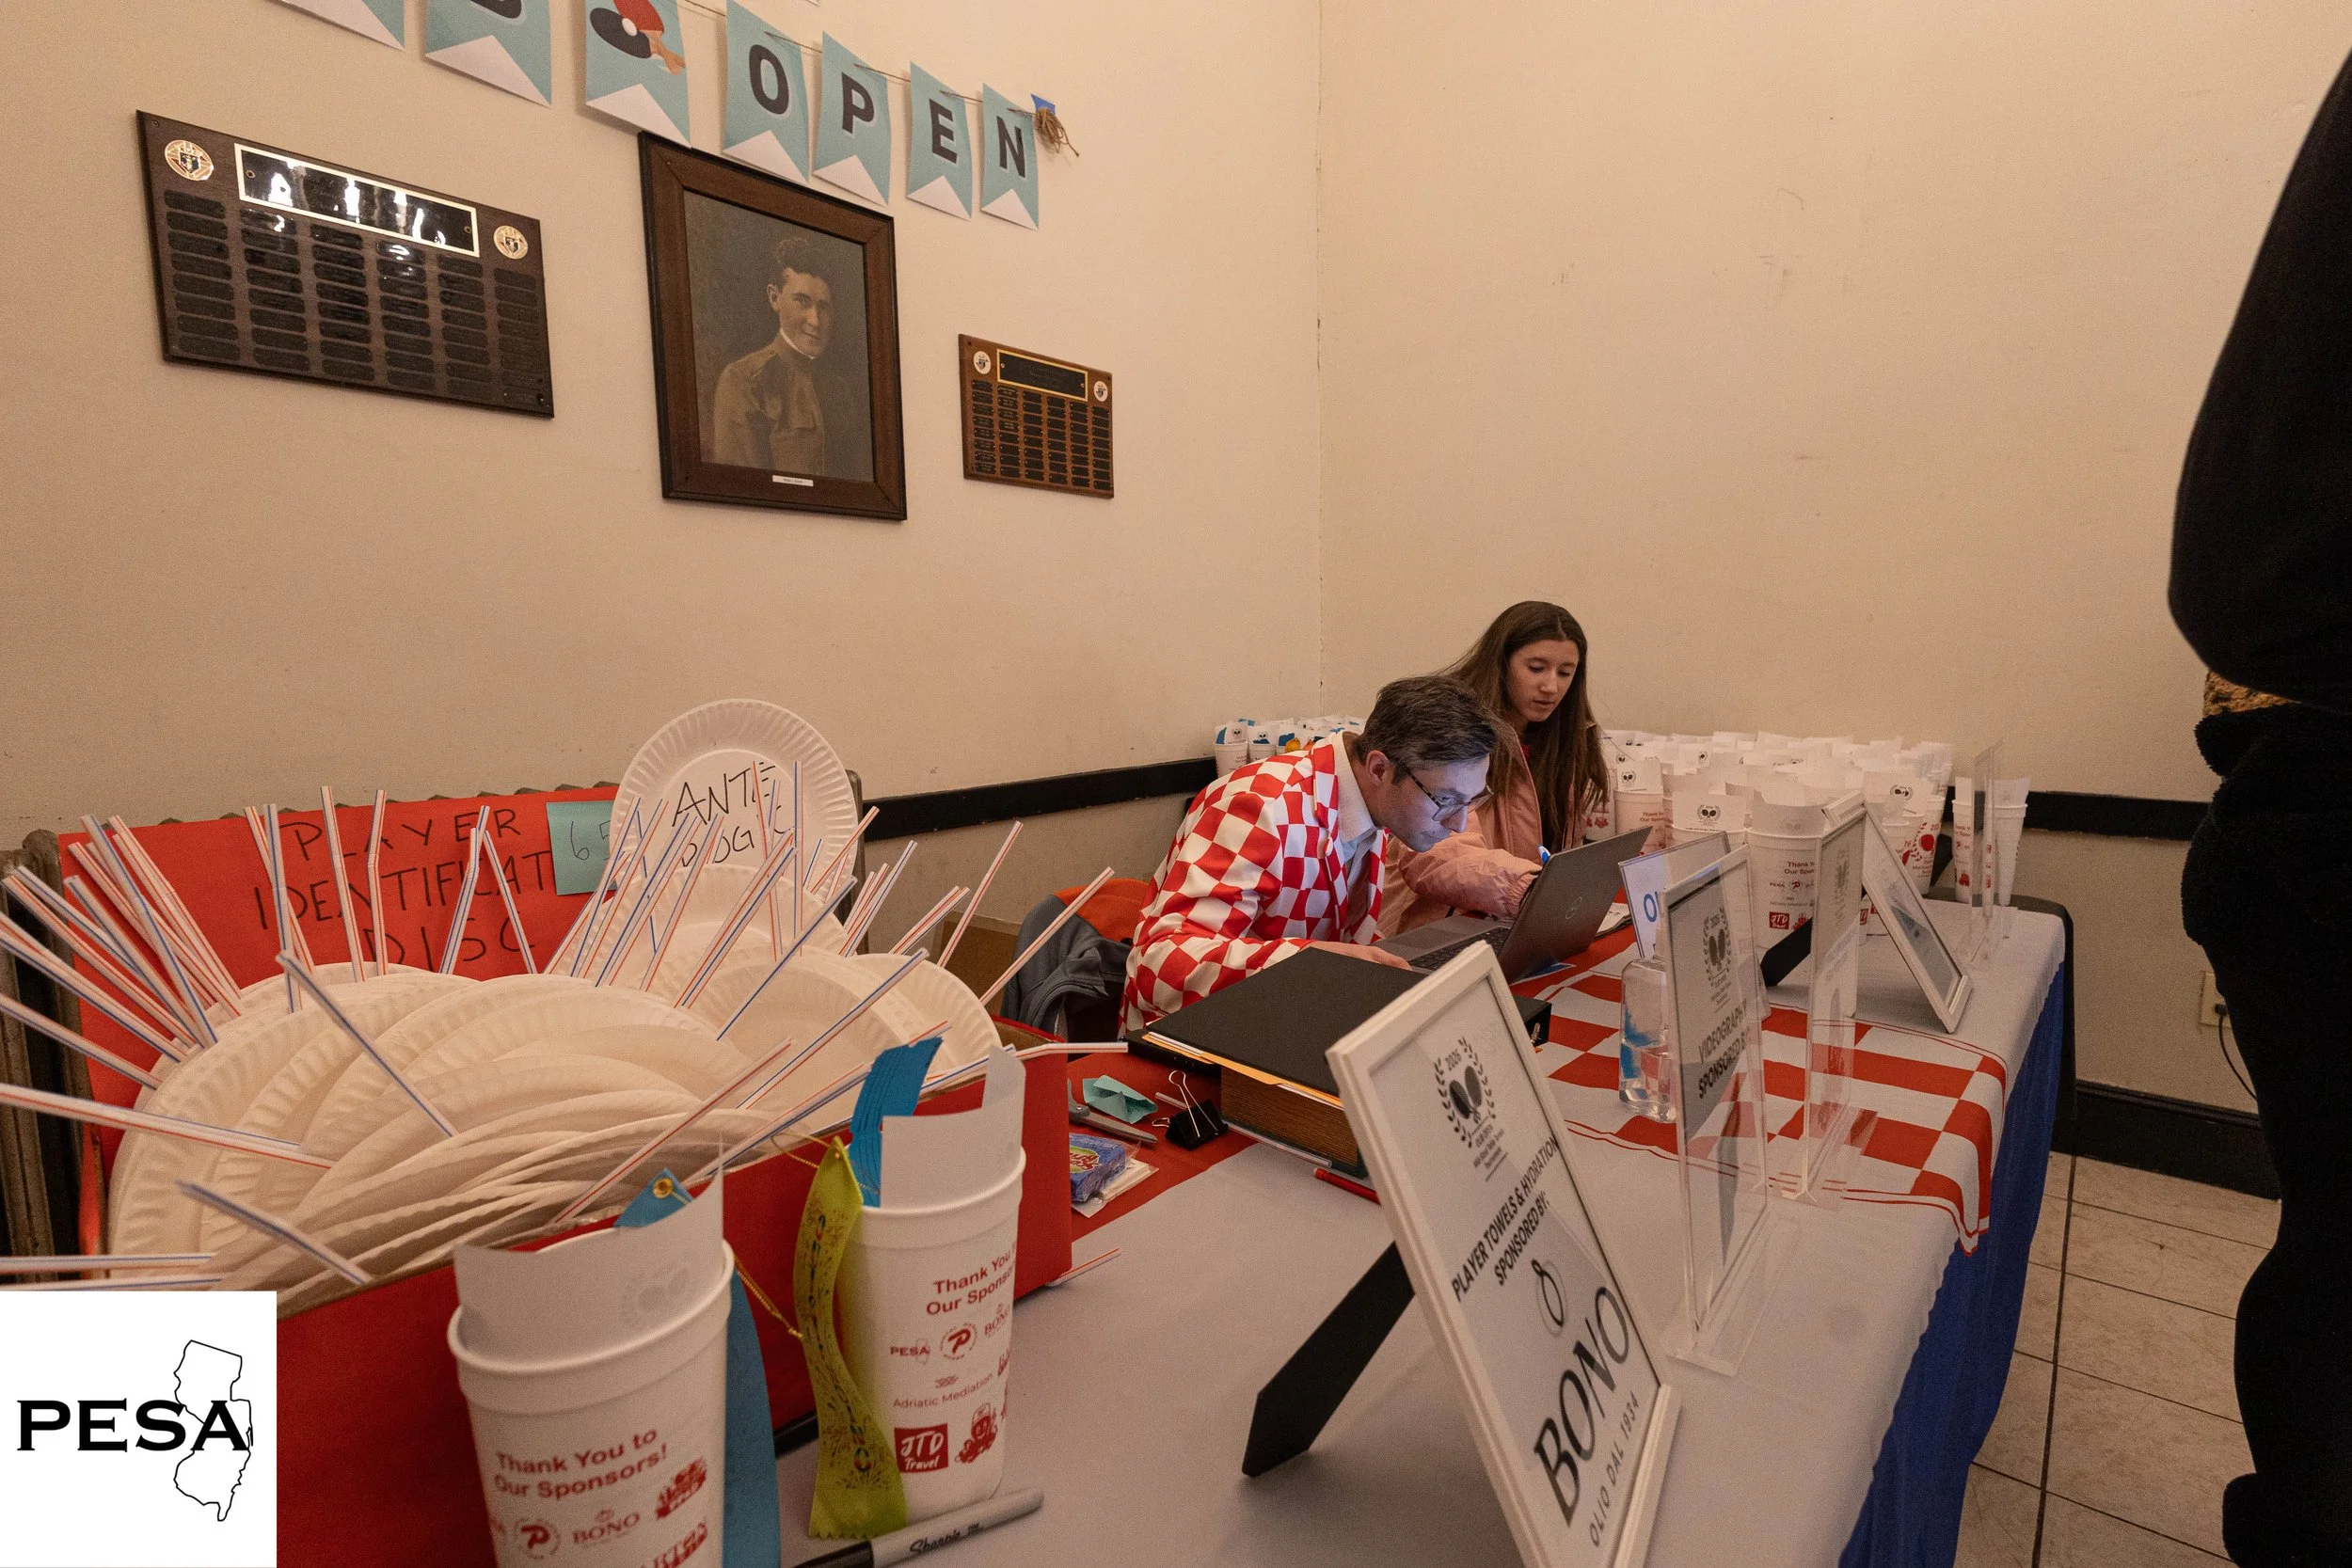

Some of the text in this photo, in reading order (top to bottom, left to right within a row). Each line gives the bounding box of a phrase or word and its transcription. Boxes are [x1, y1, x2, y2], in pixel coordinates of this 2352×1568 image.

[748, 43, 1026, 179] OPEN
[278, 808, 522, 862] PAYER
[1444, 1048, 1463, 1071] 2026
[1698, 1037, 1740, 1100] SPONSORED
[1519, 1136, 1561, 1198] HYDRATION
[1514, 1186, 1526, 1206] &
[1483, 1195, 1519, 1252] TOWELS
[1494, 1190, 1550, 1287] SPONSORED BY:
[933, 1249, 1011, 1295] Thank You
[1451, 1240, 1490, 1303] PLAYER
[926, 1297, 963, 1316] Our
[890, 1345, 931, 1357] PESA
[893, 1372, 993, 1409] Adriatic Mediation
[1534, 1286, 1630, 1528] BONO
[495, 1428, 657, 1475] Thank You to
[900, 1429, 945, 1458] JTD
[903, 1455, 941, 1471] Travel
[493, 1473, 531, 1498] Our
[536, 1442, 667, 1500] Sponsors!
[1589, 1390, 1640, 1548] OLIO DAL 1934
[572, 1511, 641, 1544] BONO
[909, 1528, 961, 1553] Sharpie
